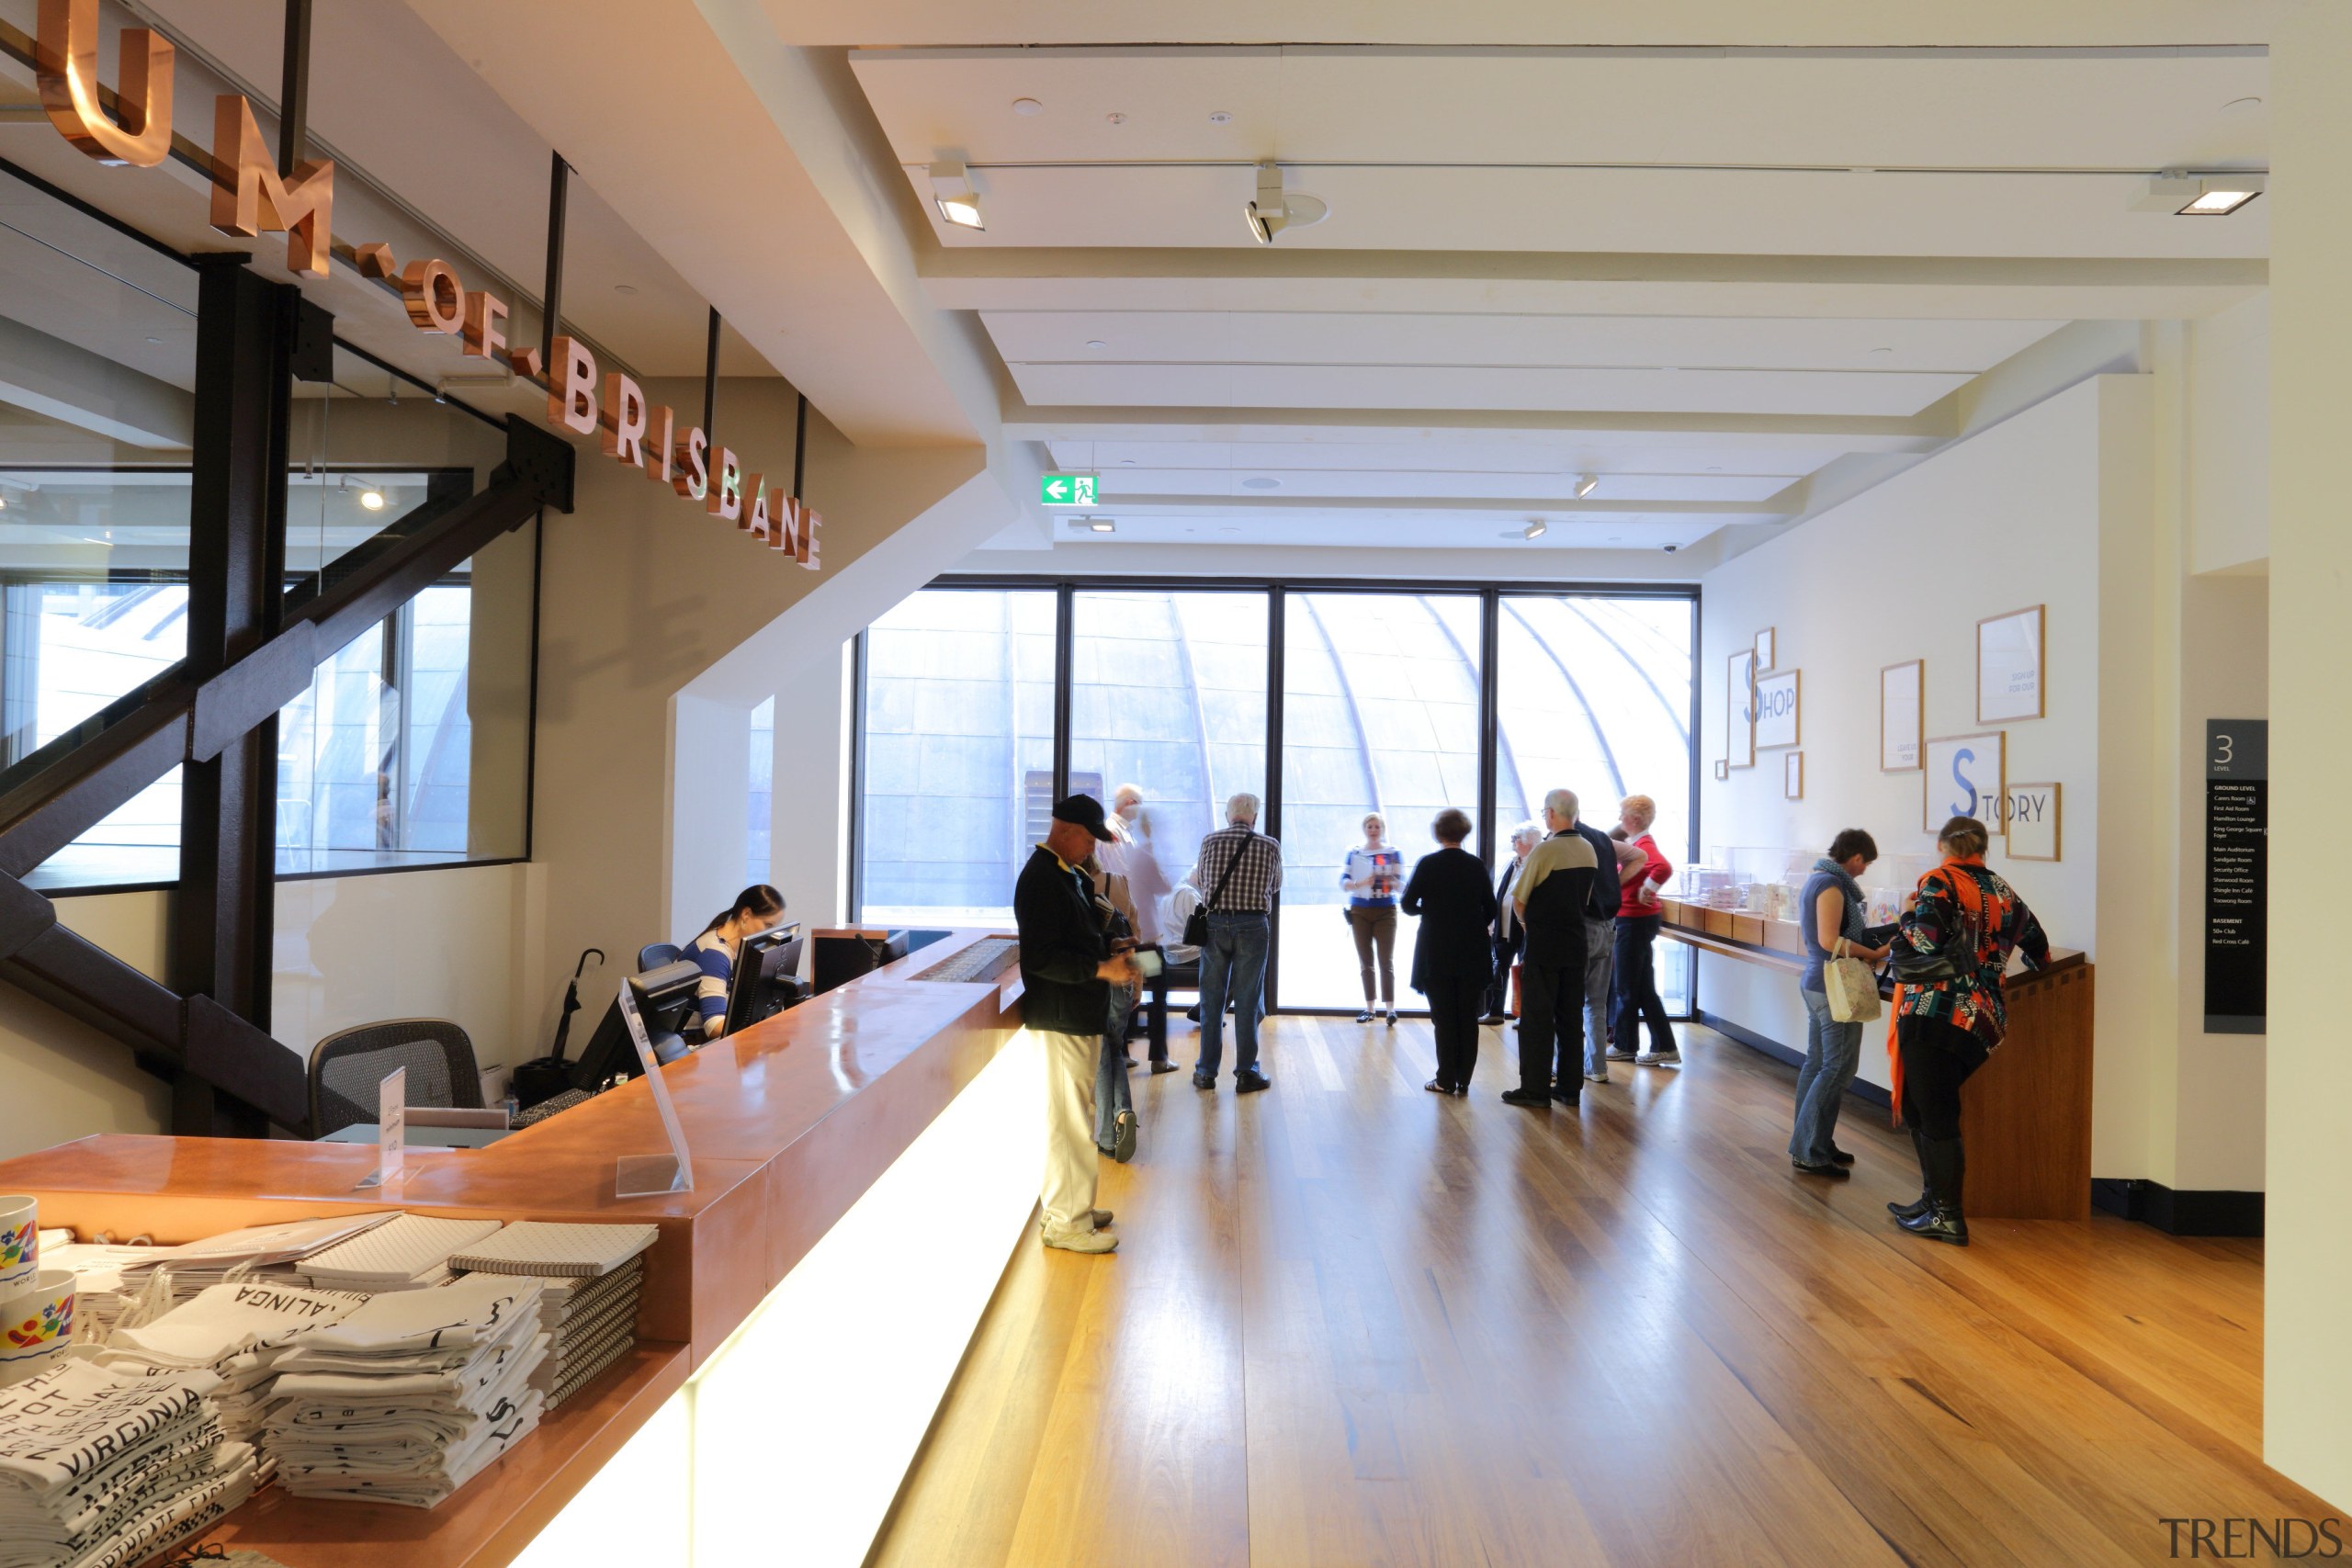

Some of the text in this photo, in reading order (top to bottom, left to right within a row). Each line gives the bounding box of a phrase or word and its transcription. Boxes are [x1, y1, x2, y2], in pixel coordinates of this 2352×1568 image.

[402, 258, 509, 360] OF
[547, 335, 823, 570] BRISBANE
[1743, 654, 1795, 724] SHOP
[2012, 670, 2035, 681] SIGN UP
[2214, 734, 2233, 764] 3
[1950, 748, 2046, 823] STORY
[234, 1286, 336, 1317] ALINGA
[0, 1389, 69, 1425] POT
[54, 1383, 127, 1417] QUAY
[57, 1387, 200, 1479] VIRGINIA
